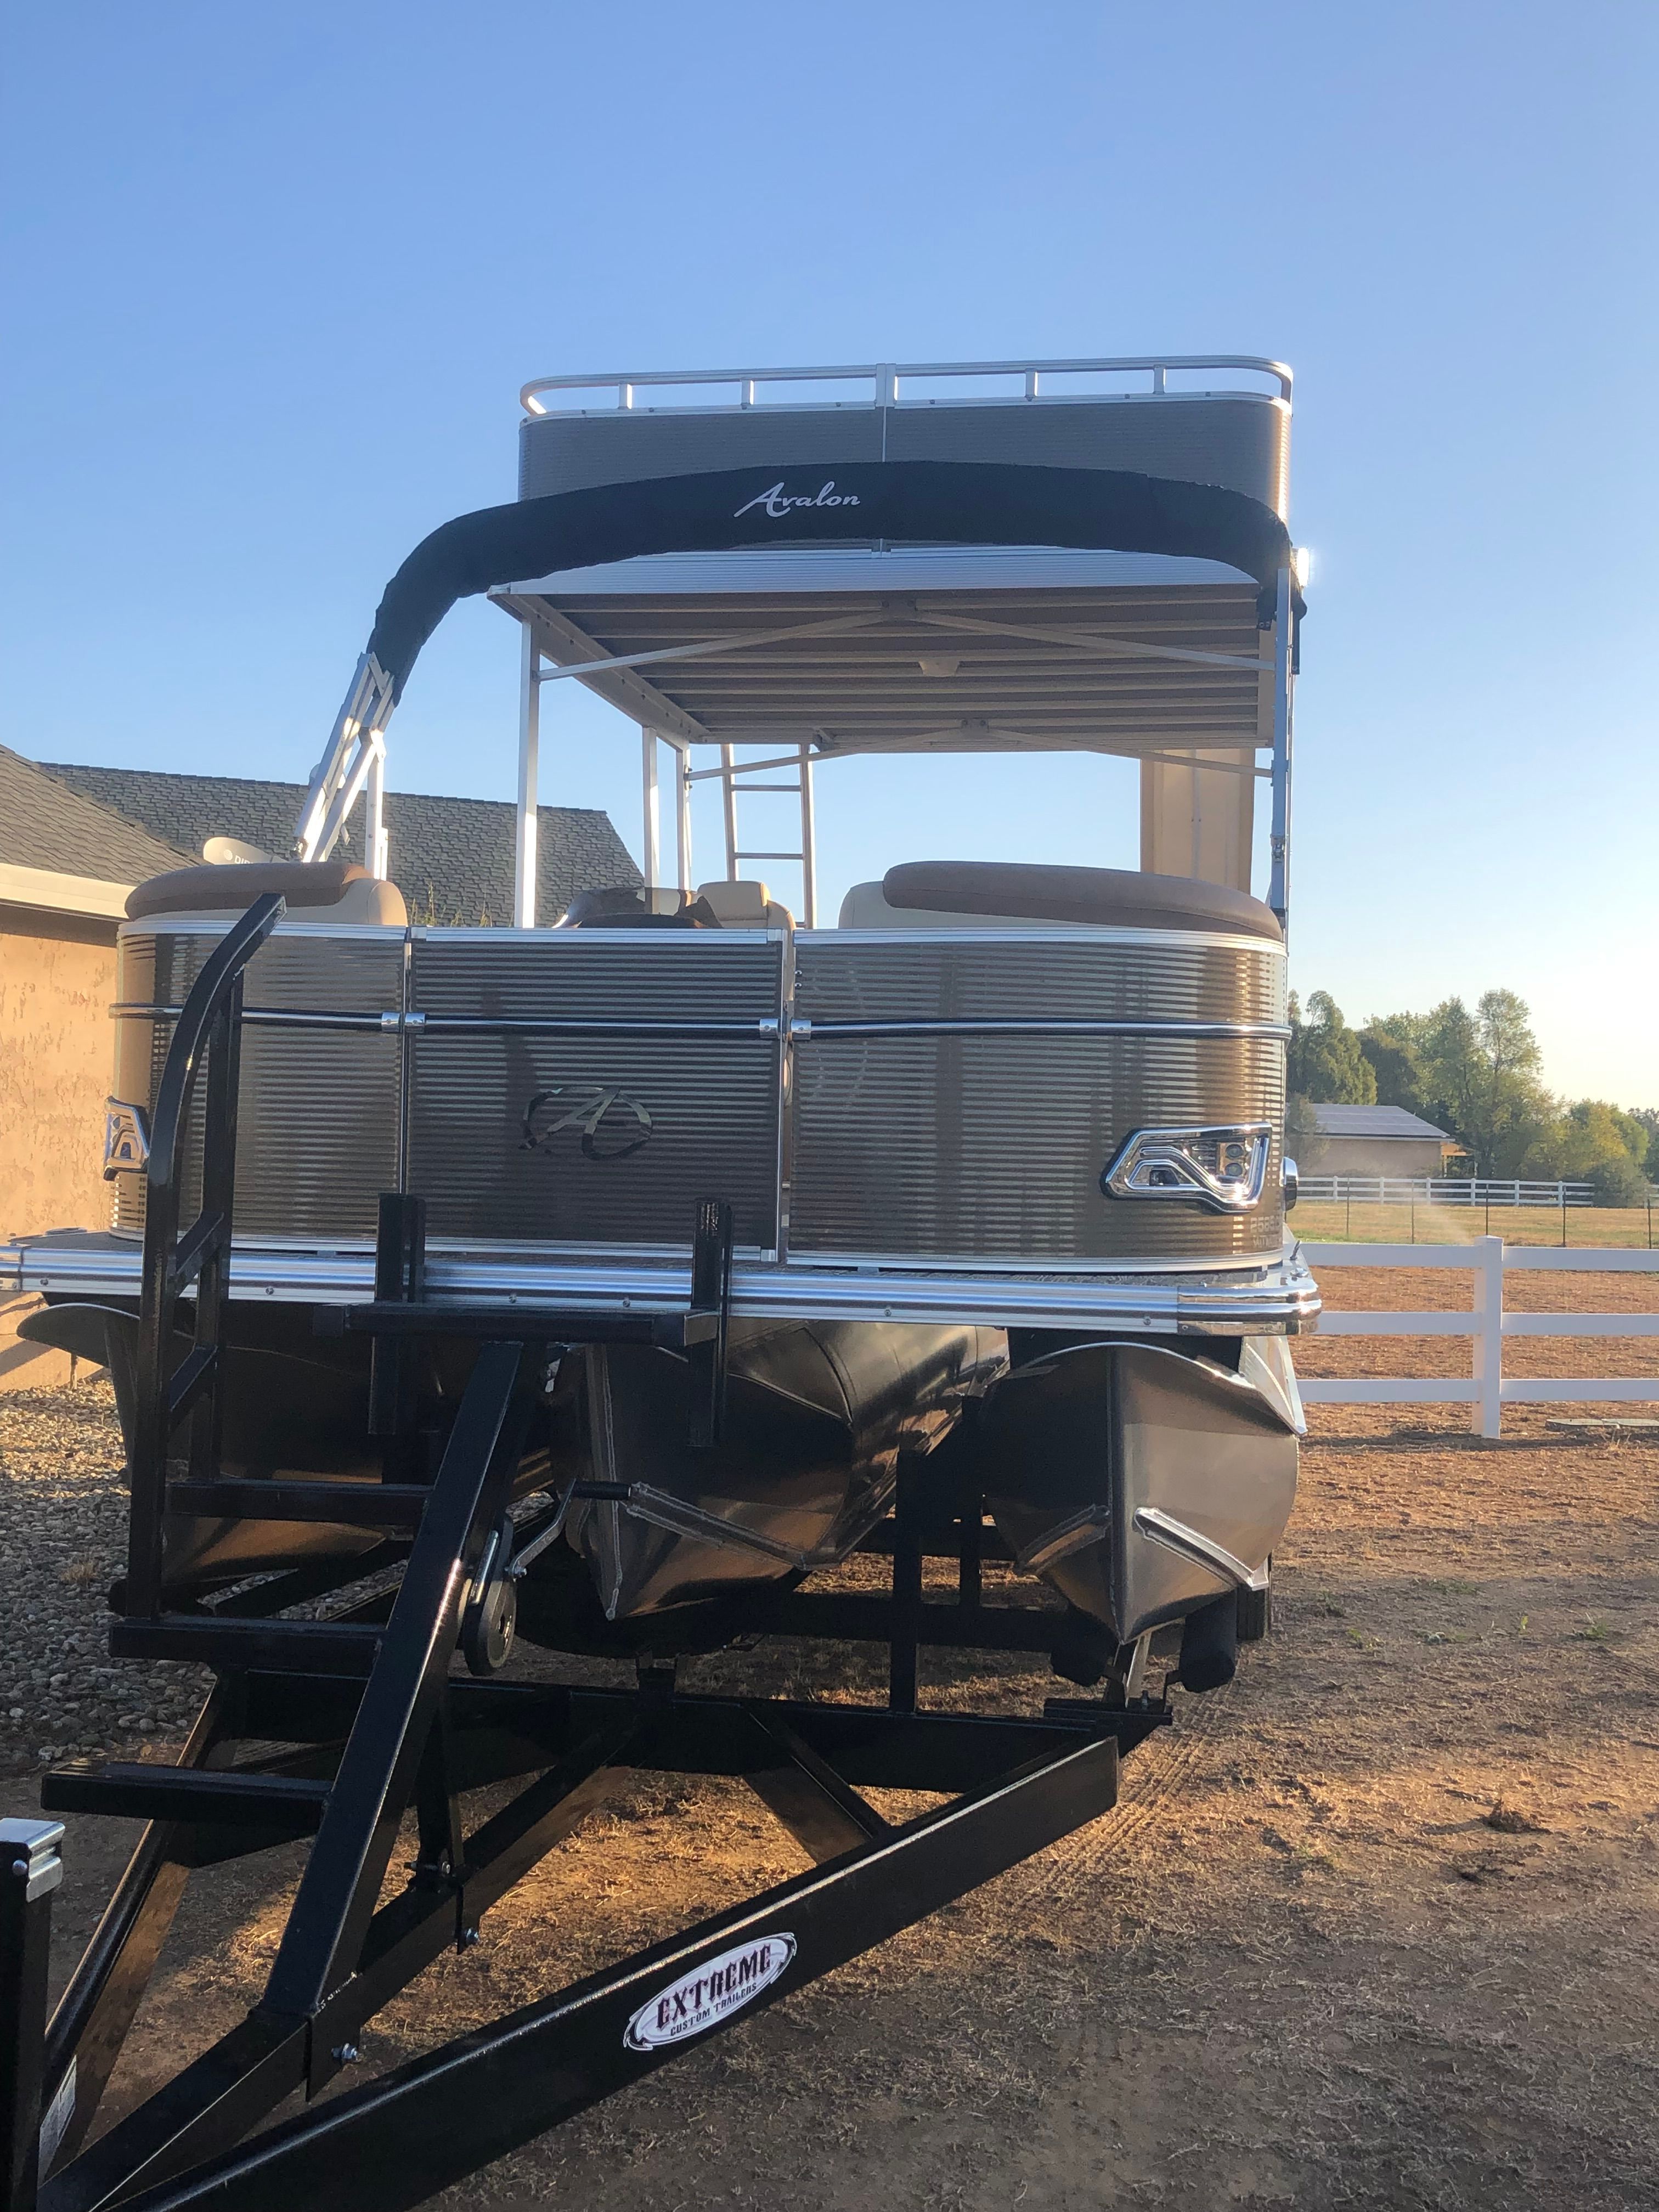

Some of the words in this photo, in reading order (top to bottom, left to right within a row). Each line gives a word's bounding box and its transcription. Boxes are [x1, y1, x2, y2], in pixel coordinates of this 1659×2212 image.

[733, 481, 861, 517] Avalon
[657, 1944, 771, 2030] EXTREME
[670, 2008, 710, 2036] CUSTOM
[714, 1982, 757, 2012] TRAILERS
